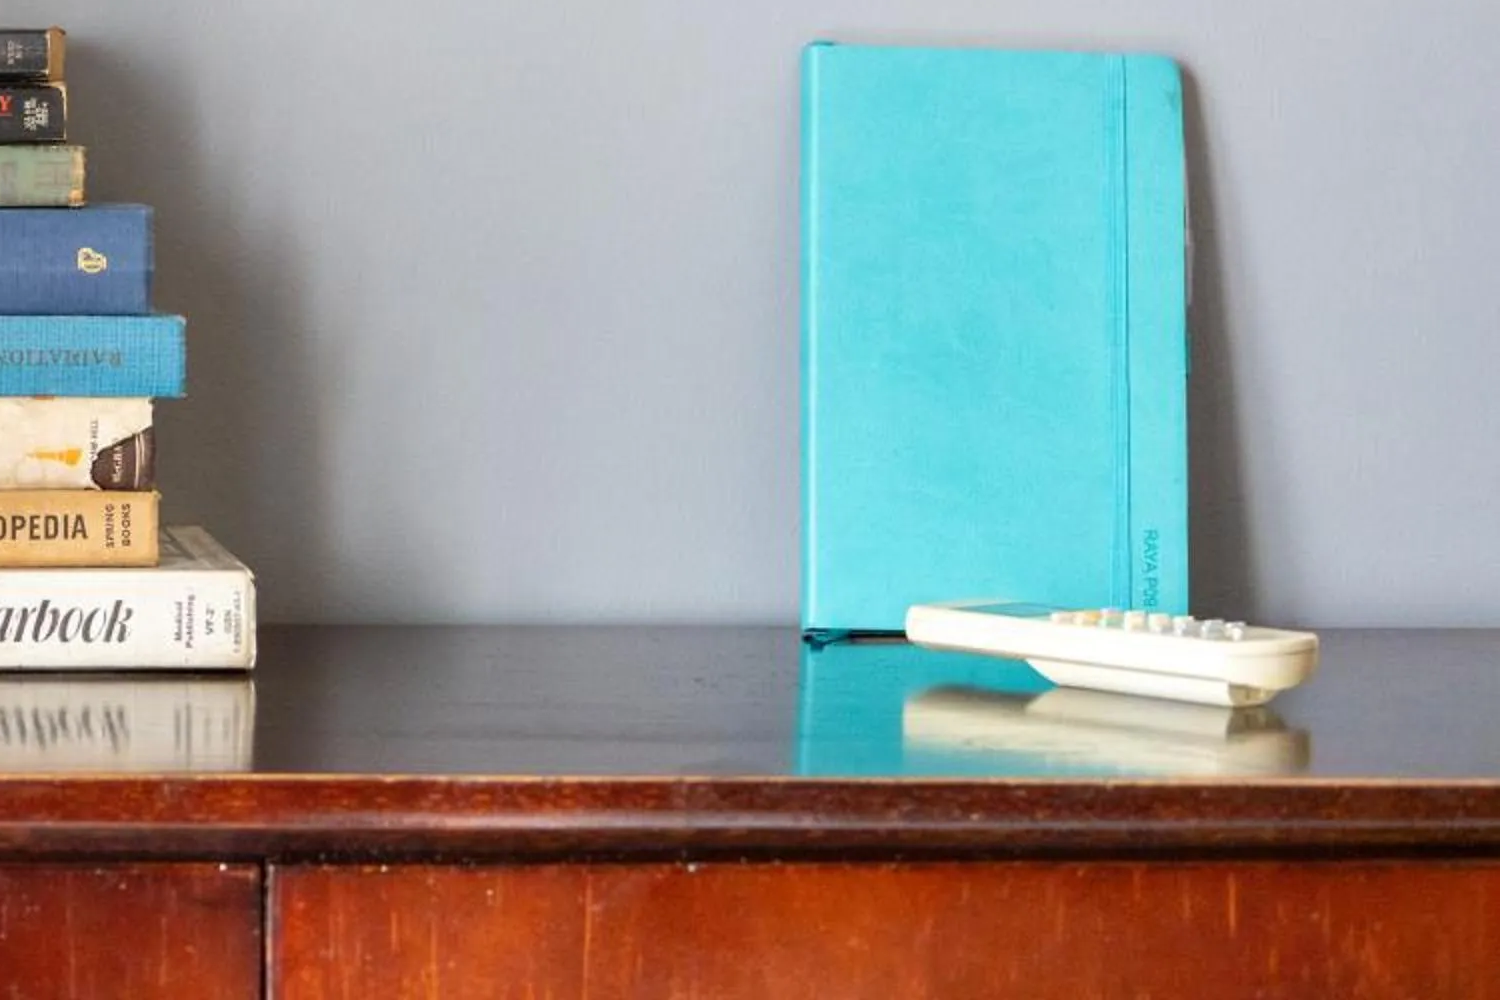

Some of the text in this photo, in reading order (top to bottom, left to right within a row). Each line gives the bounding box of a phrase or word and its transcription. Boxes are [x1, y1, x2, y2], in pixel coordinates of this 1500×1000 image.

[105, 503, 116, 549] SPRING
[121, 502, 132, 547] BOOKS
[1142, 528, 1160, 574] RAYA
